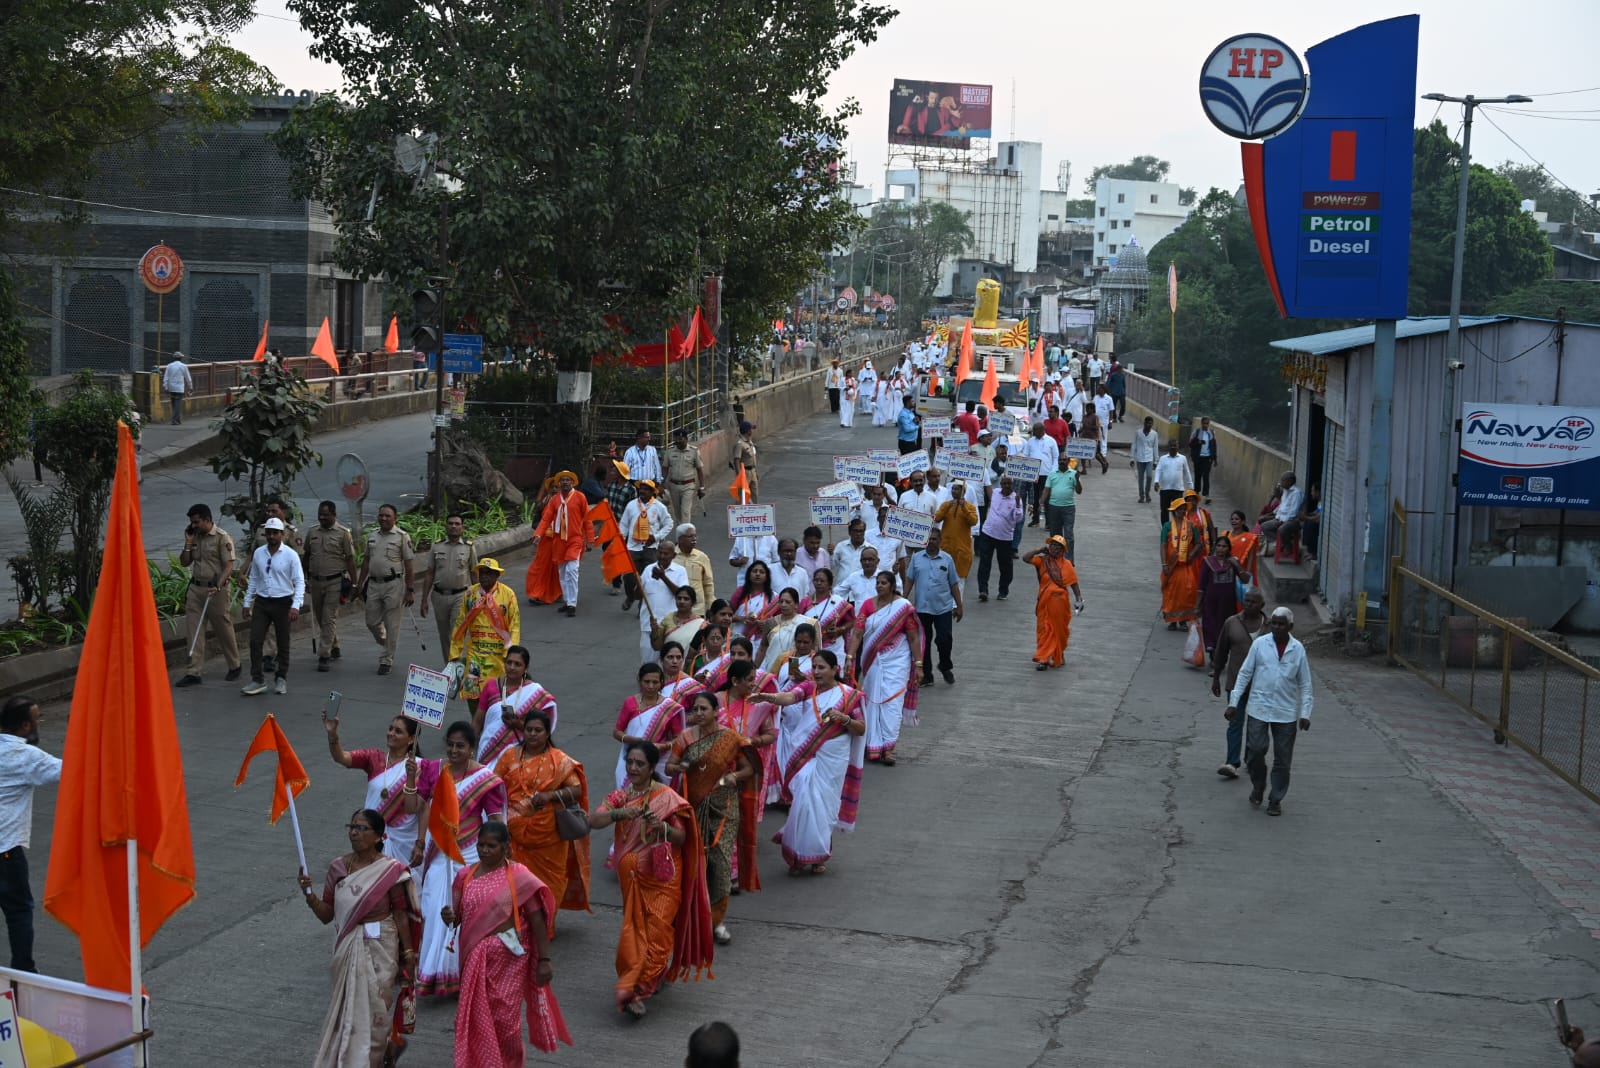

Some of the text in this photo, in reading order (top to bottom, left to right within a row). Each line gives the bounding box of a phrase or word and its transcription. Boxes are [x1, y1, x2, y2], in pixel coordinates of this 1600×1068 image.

[1228, 48, 1284, 78] HP
[962, 94, 988, 103] DELIGHT
[1310, 217, 1371, 231] Petrol
[1309, 239, 1370, 253] Diesel
[1500, 440, 1524, 448] India,
[1548, 443, 1580, 451] Energy
[736, 513, 768, 523] गोदामाई
[819, 515, 842, 525] नाशिक
